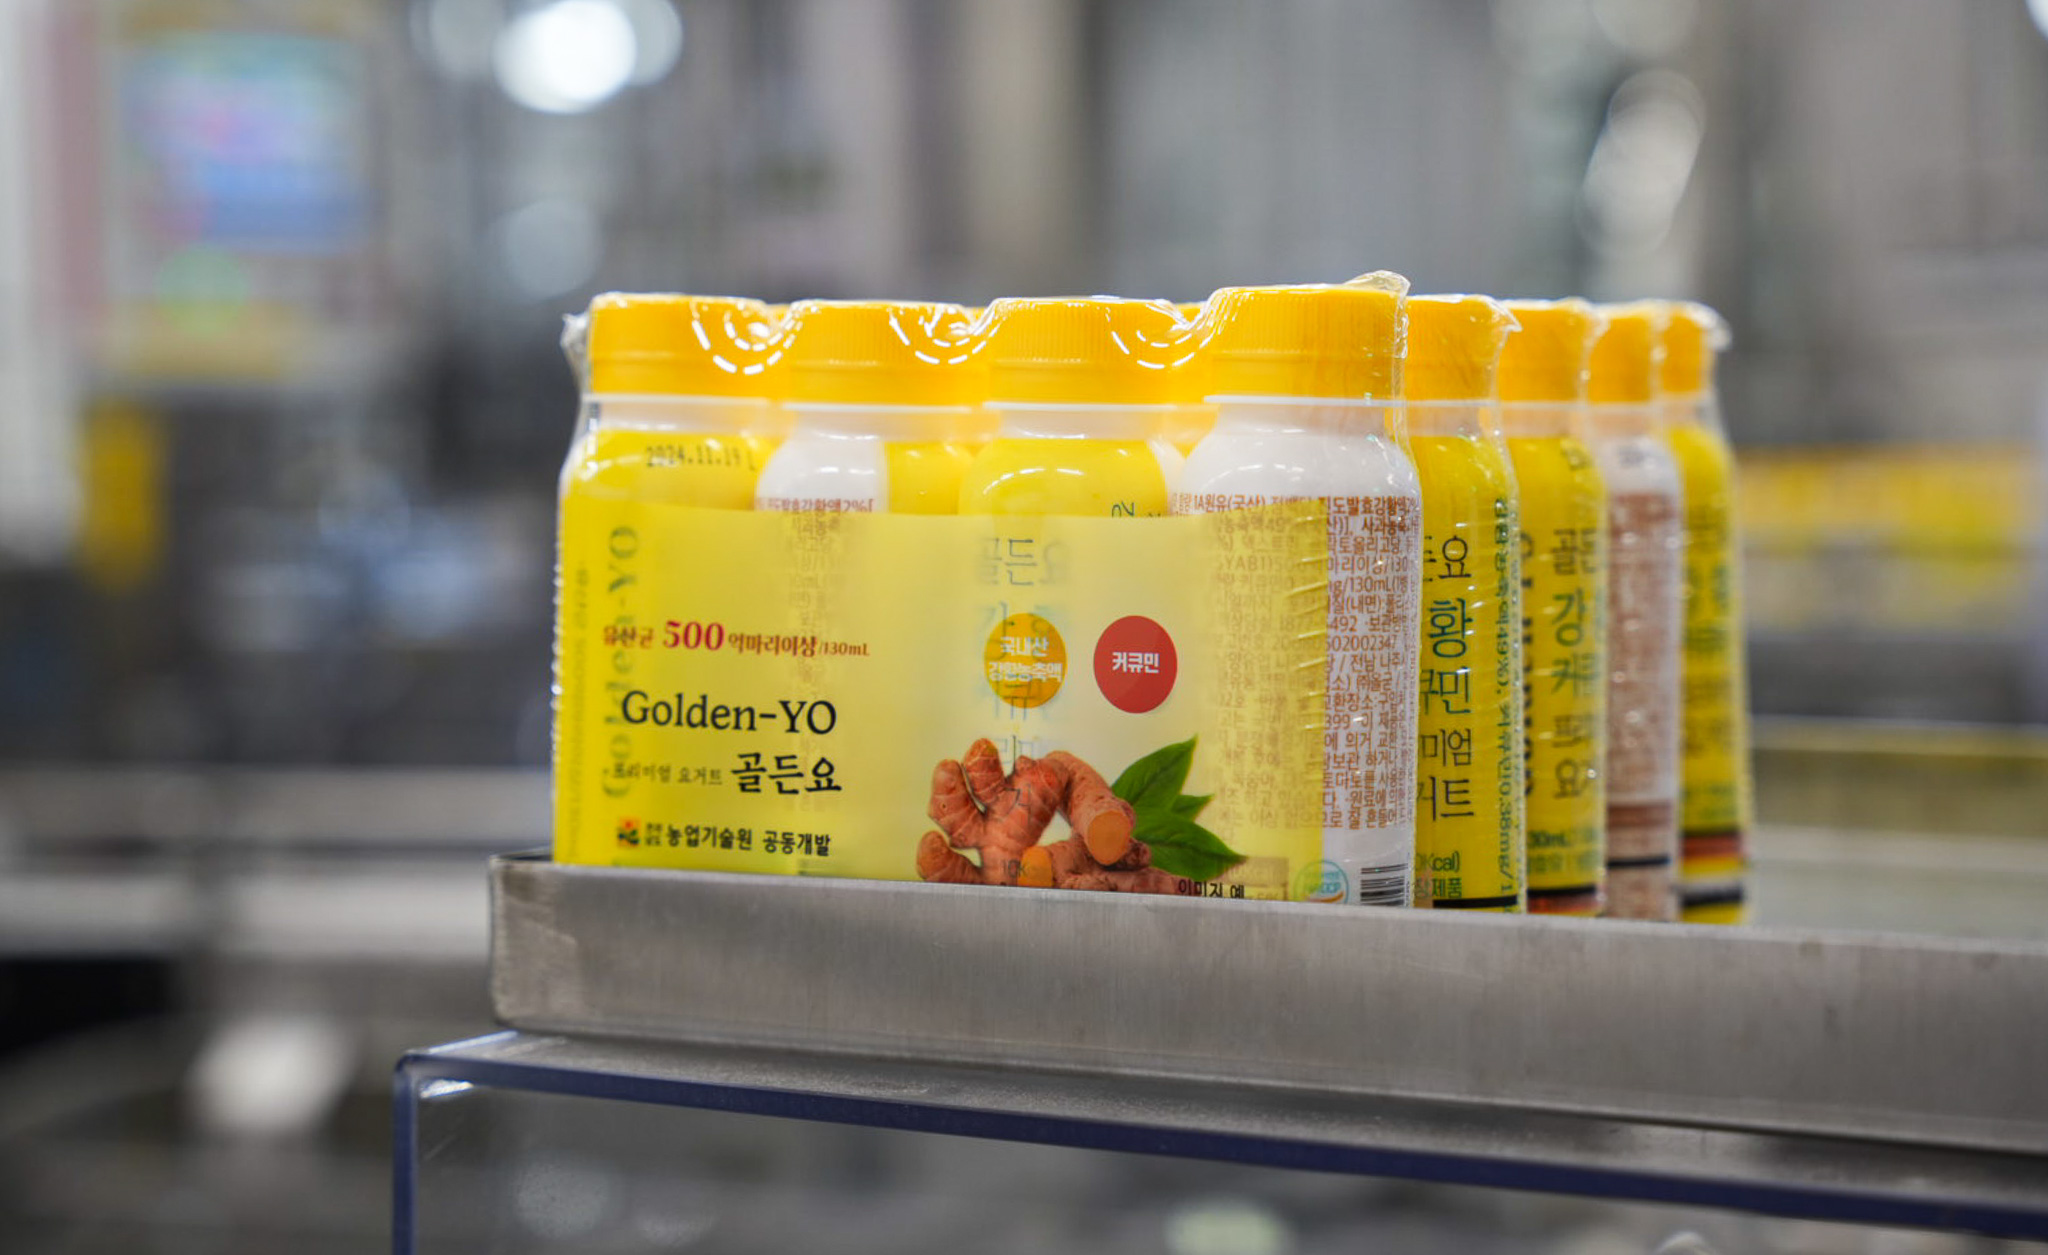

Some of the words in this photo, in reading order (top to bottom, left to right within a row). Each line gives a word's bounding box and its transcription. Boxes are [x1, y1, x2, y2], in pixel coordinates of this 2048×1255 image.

[662, 620, 724, 651] 500
[1000, 636, 1050, 657] 국내산
[1111, 651, 1160, 674] 커큐민
[621, 690, 838, 735] Golden-YO
[730, 752, 843, 796] 골든요
[762, 829, 832, 857] 공동개발
